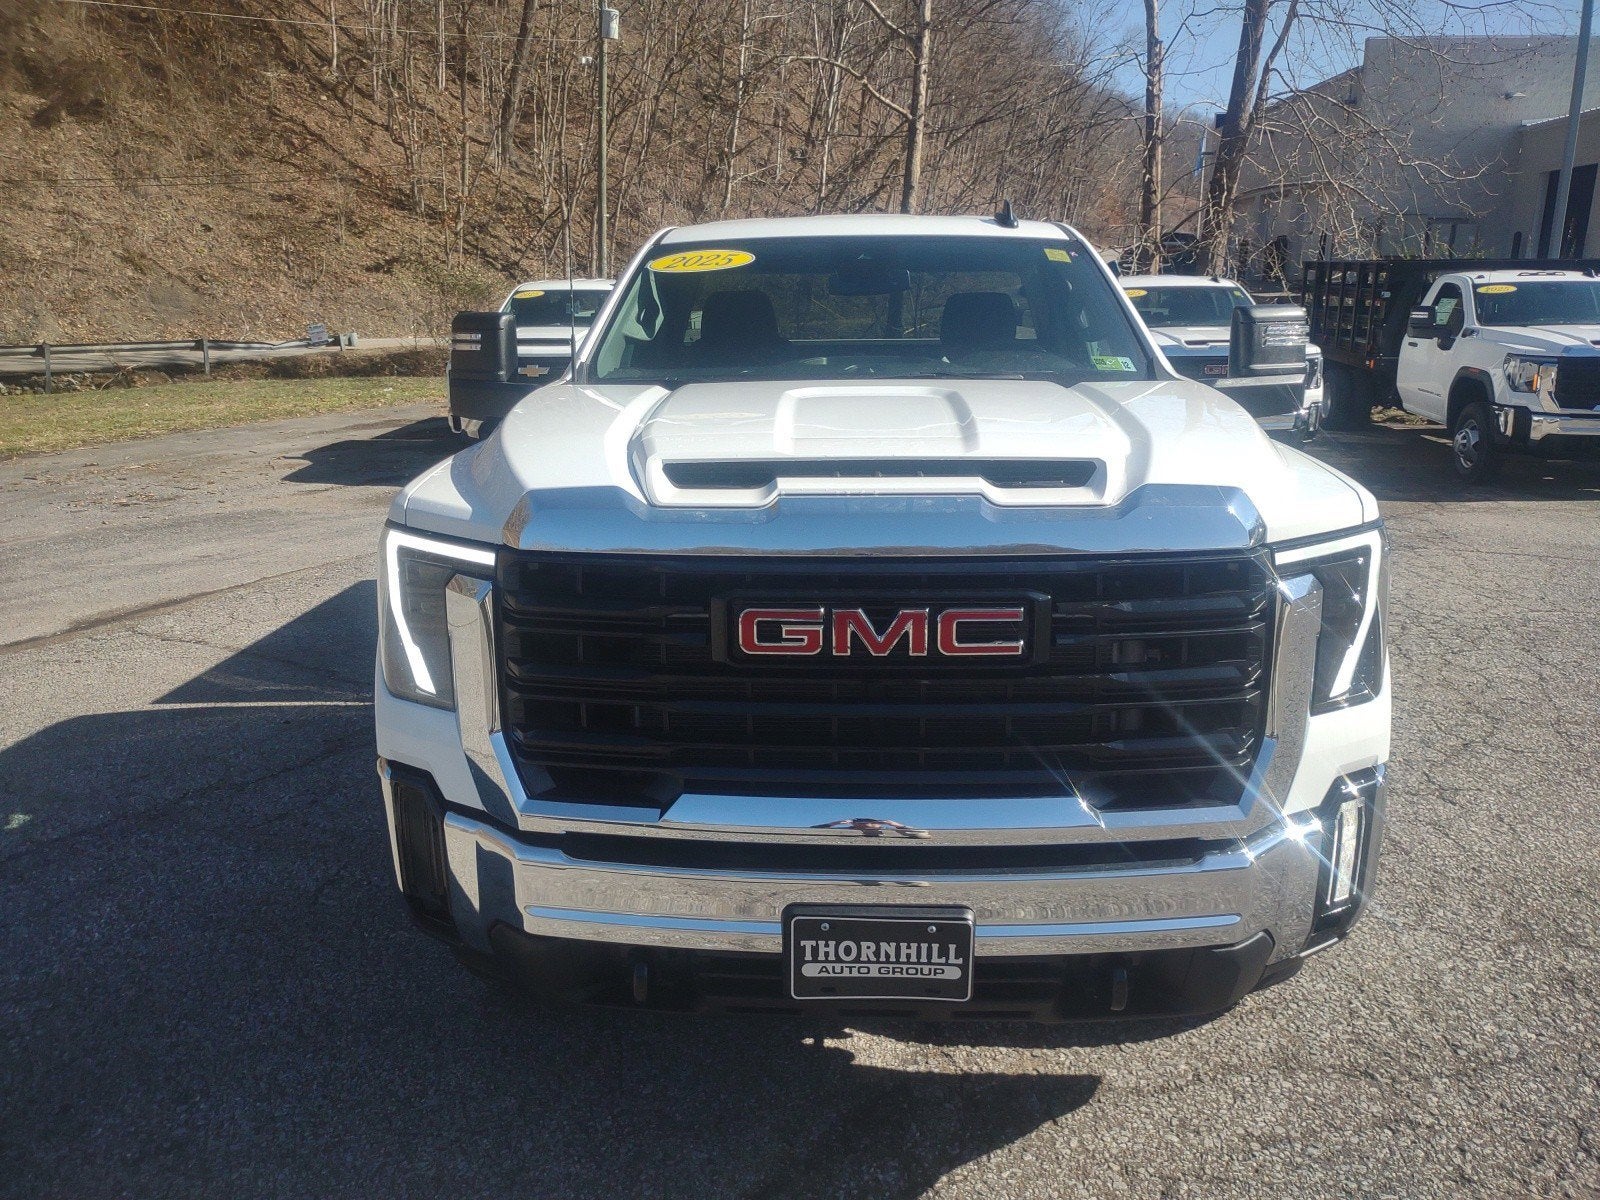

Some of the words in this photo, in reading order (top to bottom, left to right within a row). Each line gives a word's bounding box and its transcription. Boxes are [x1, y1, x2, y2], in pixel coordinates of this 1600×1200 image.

[663, 253, 741, 270] 2025
[738, 607, 1025, 656] GMC
[800, 939, 964, 965] THORNHILL
[818, 965, 871, 976] AUTO
[877, 966, 946, 977] GROUP
